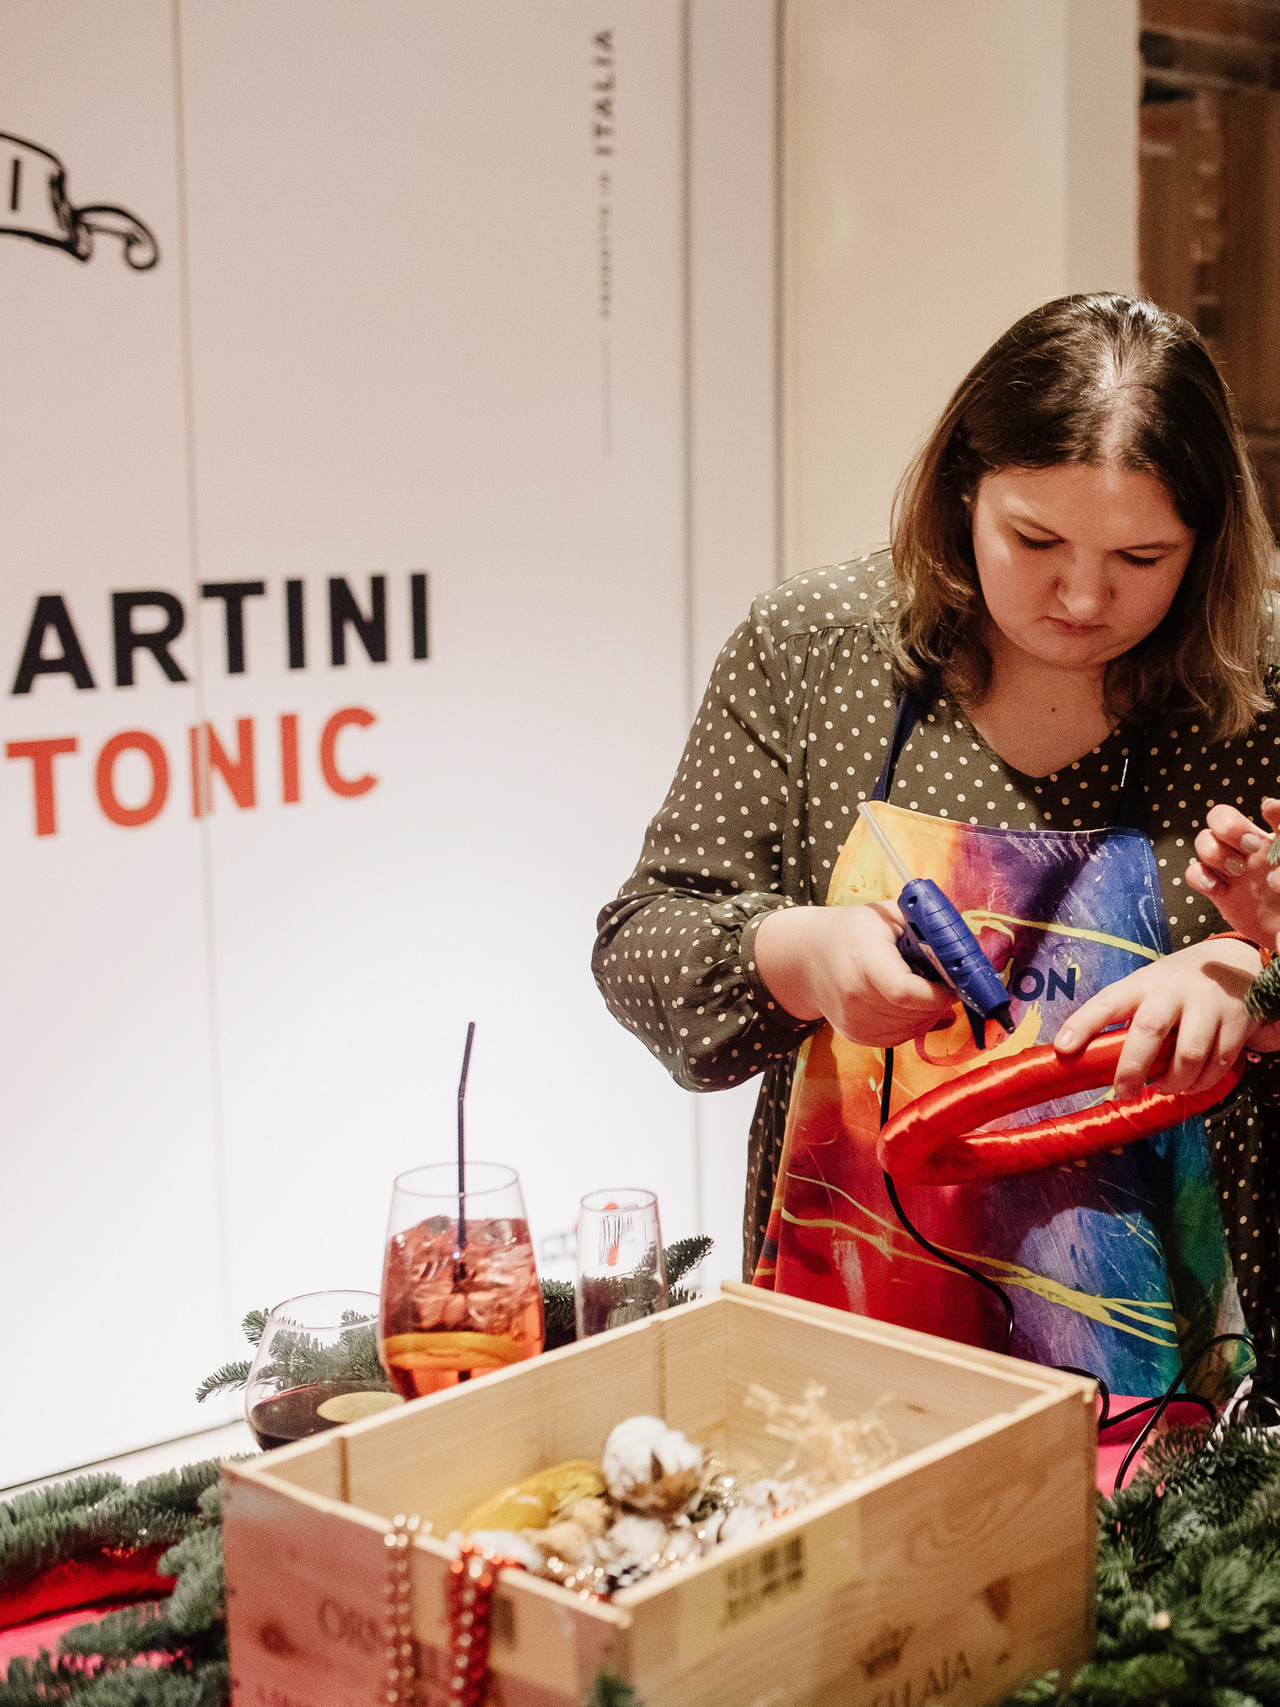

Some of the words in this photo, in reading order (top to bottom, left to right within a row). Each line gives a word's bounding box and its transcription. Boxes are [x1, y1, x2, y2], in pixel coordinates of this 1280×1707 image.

[590, 28, 615, 157] ITALIA
[11, 571, 430, 695] ARTINI
[5, 704, 380, 837] TONIC
